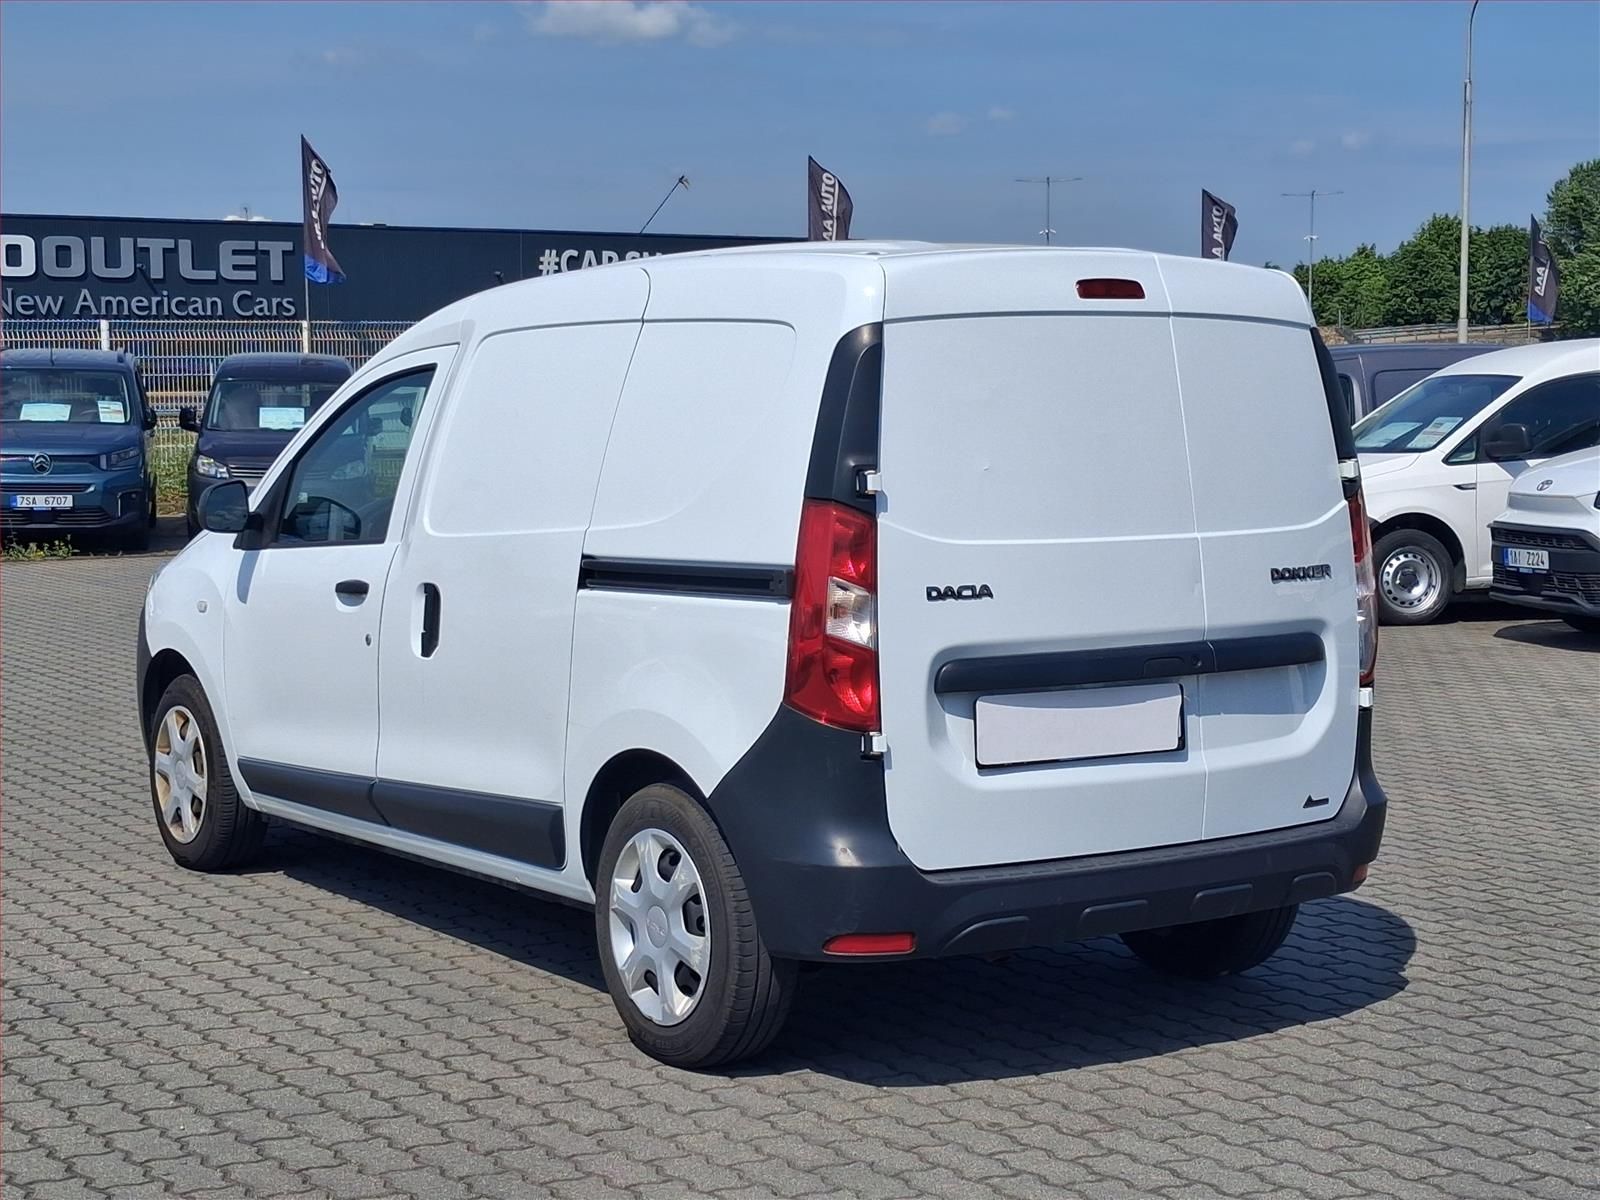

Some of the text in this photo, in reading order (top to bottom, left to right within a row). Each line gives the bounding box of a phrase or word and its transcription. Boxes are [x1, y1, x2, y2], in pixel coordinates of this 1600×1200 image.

[821, 172, 835, 217] AUTO
[72, 288, 223, 316] American
[232, 290, 296, 316] Cars
[19, 496, 68, 506] 7SA 6707
[926, 584, 994, 602] DACIA
